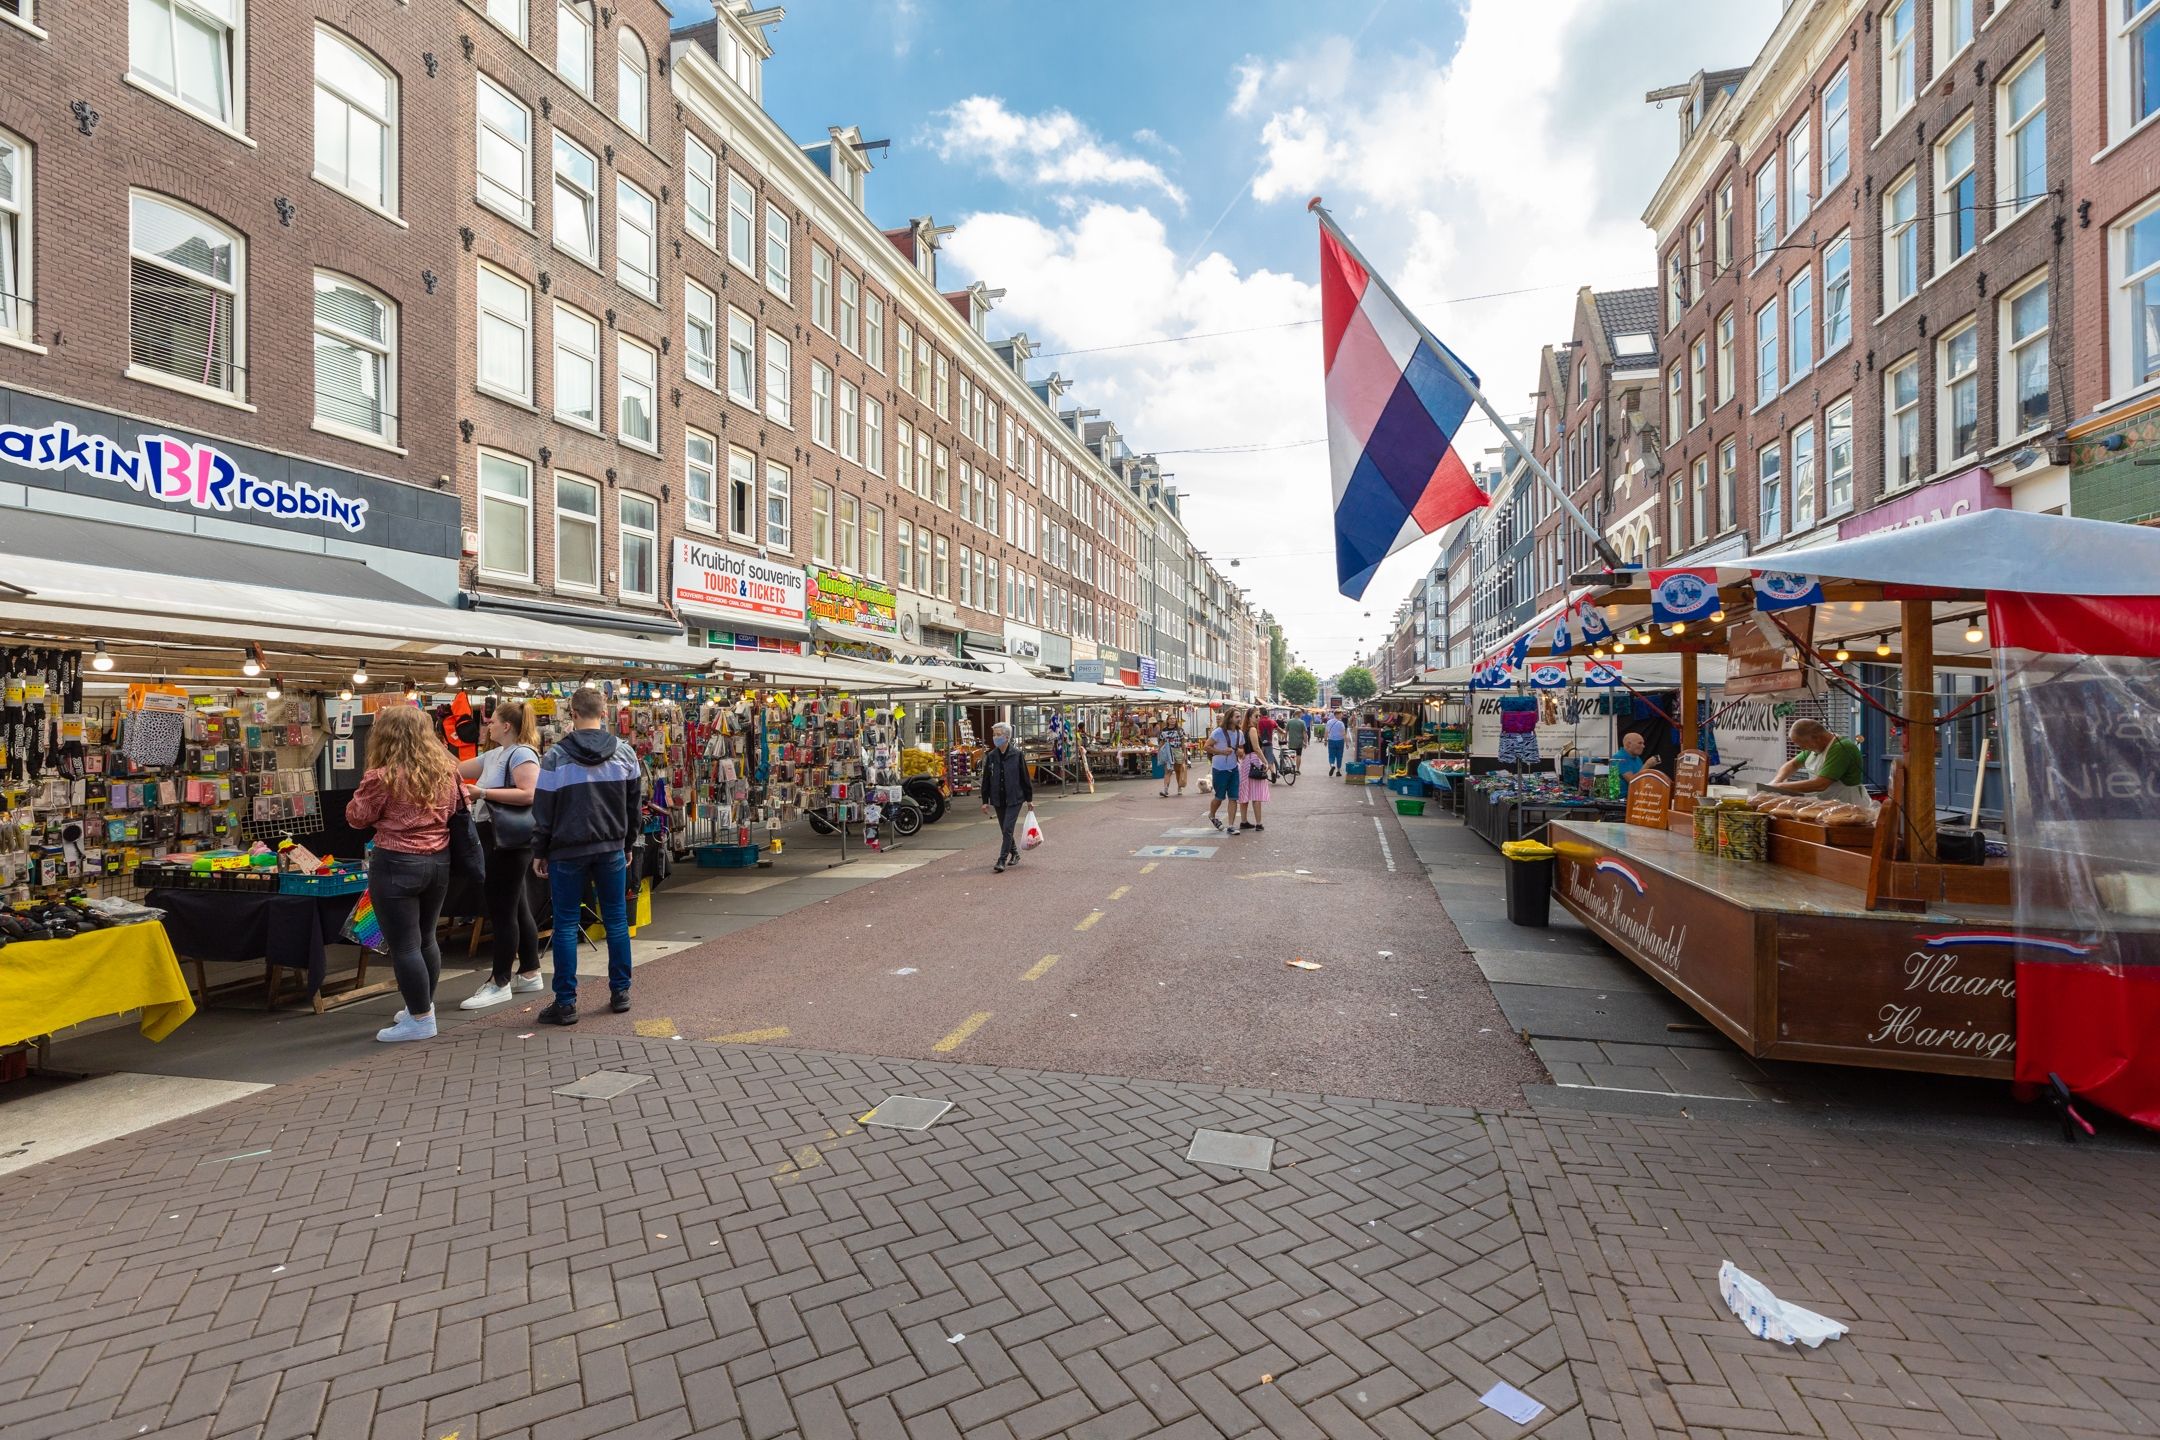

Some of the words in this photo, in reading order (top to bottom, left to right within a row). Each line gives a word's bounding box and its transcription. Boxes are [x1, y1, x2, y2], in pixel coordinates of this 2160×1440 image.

[691, 546, 745, 575] Kruithof
[749, 565, 801, 589] souvenirs
[704, 572, 737, 594] TOURS
[740, 580, 746, 596] &
[749, 581, 785, 604] TICKETS
[818, 572, 855, 598] Horeca
[1609, 884, 1686, 970] Haringhandel
[1868, 1003, 2016, 1058] Haring
